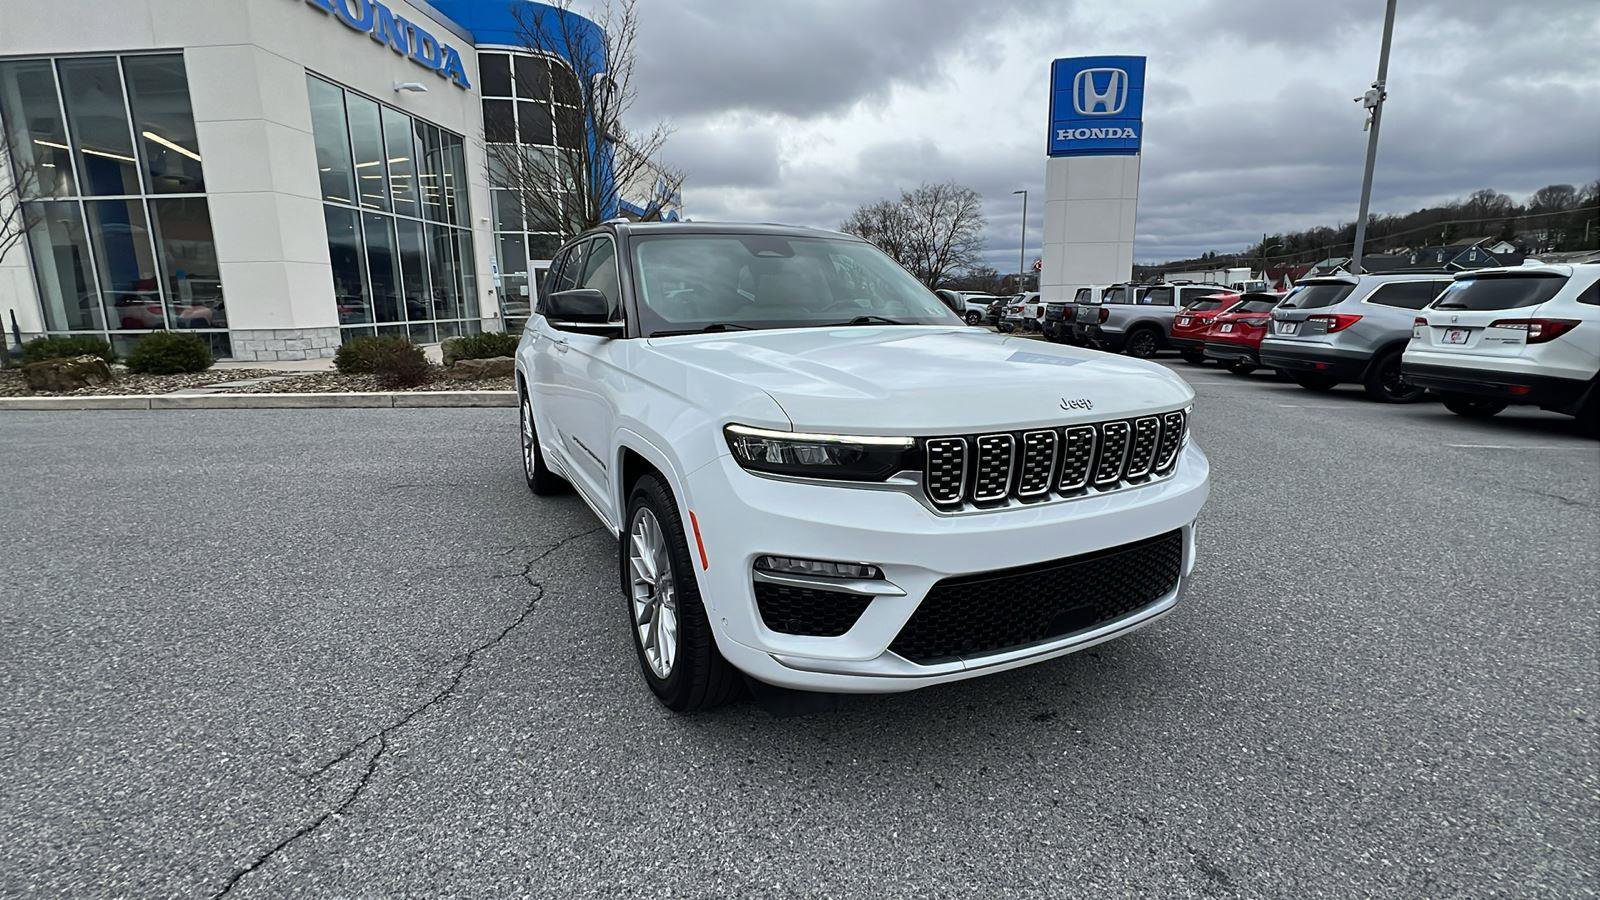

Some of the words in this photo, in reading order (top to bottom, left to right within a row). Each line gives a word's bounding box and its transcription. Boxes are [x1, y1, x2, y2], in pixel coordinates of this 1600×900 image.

[304, 0, 471, 91] ONDA
[1056, 127, 1138, 141] HONDA
[1060, 397, 1094, 411] Jeep
